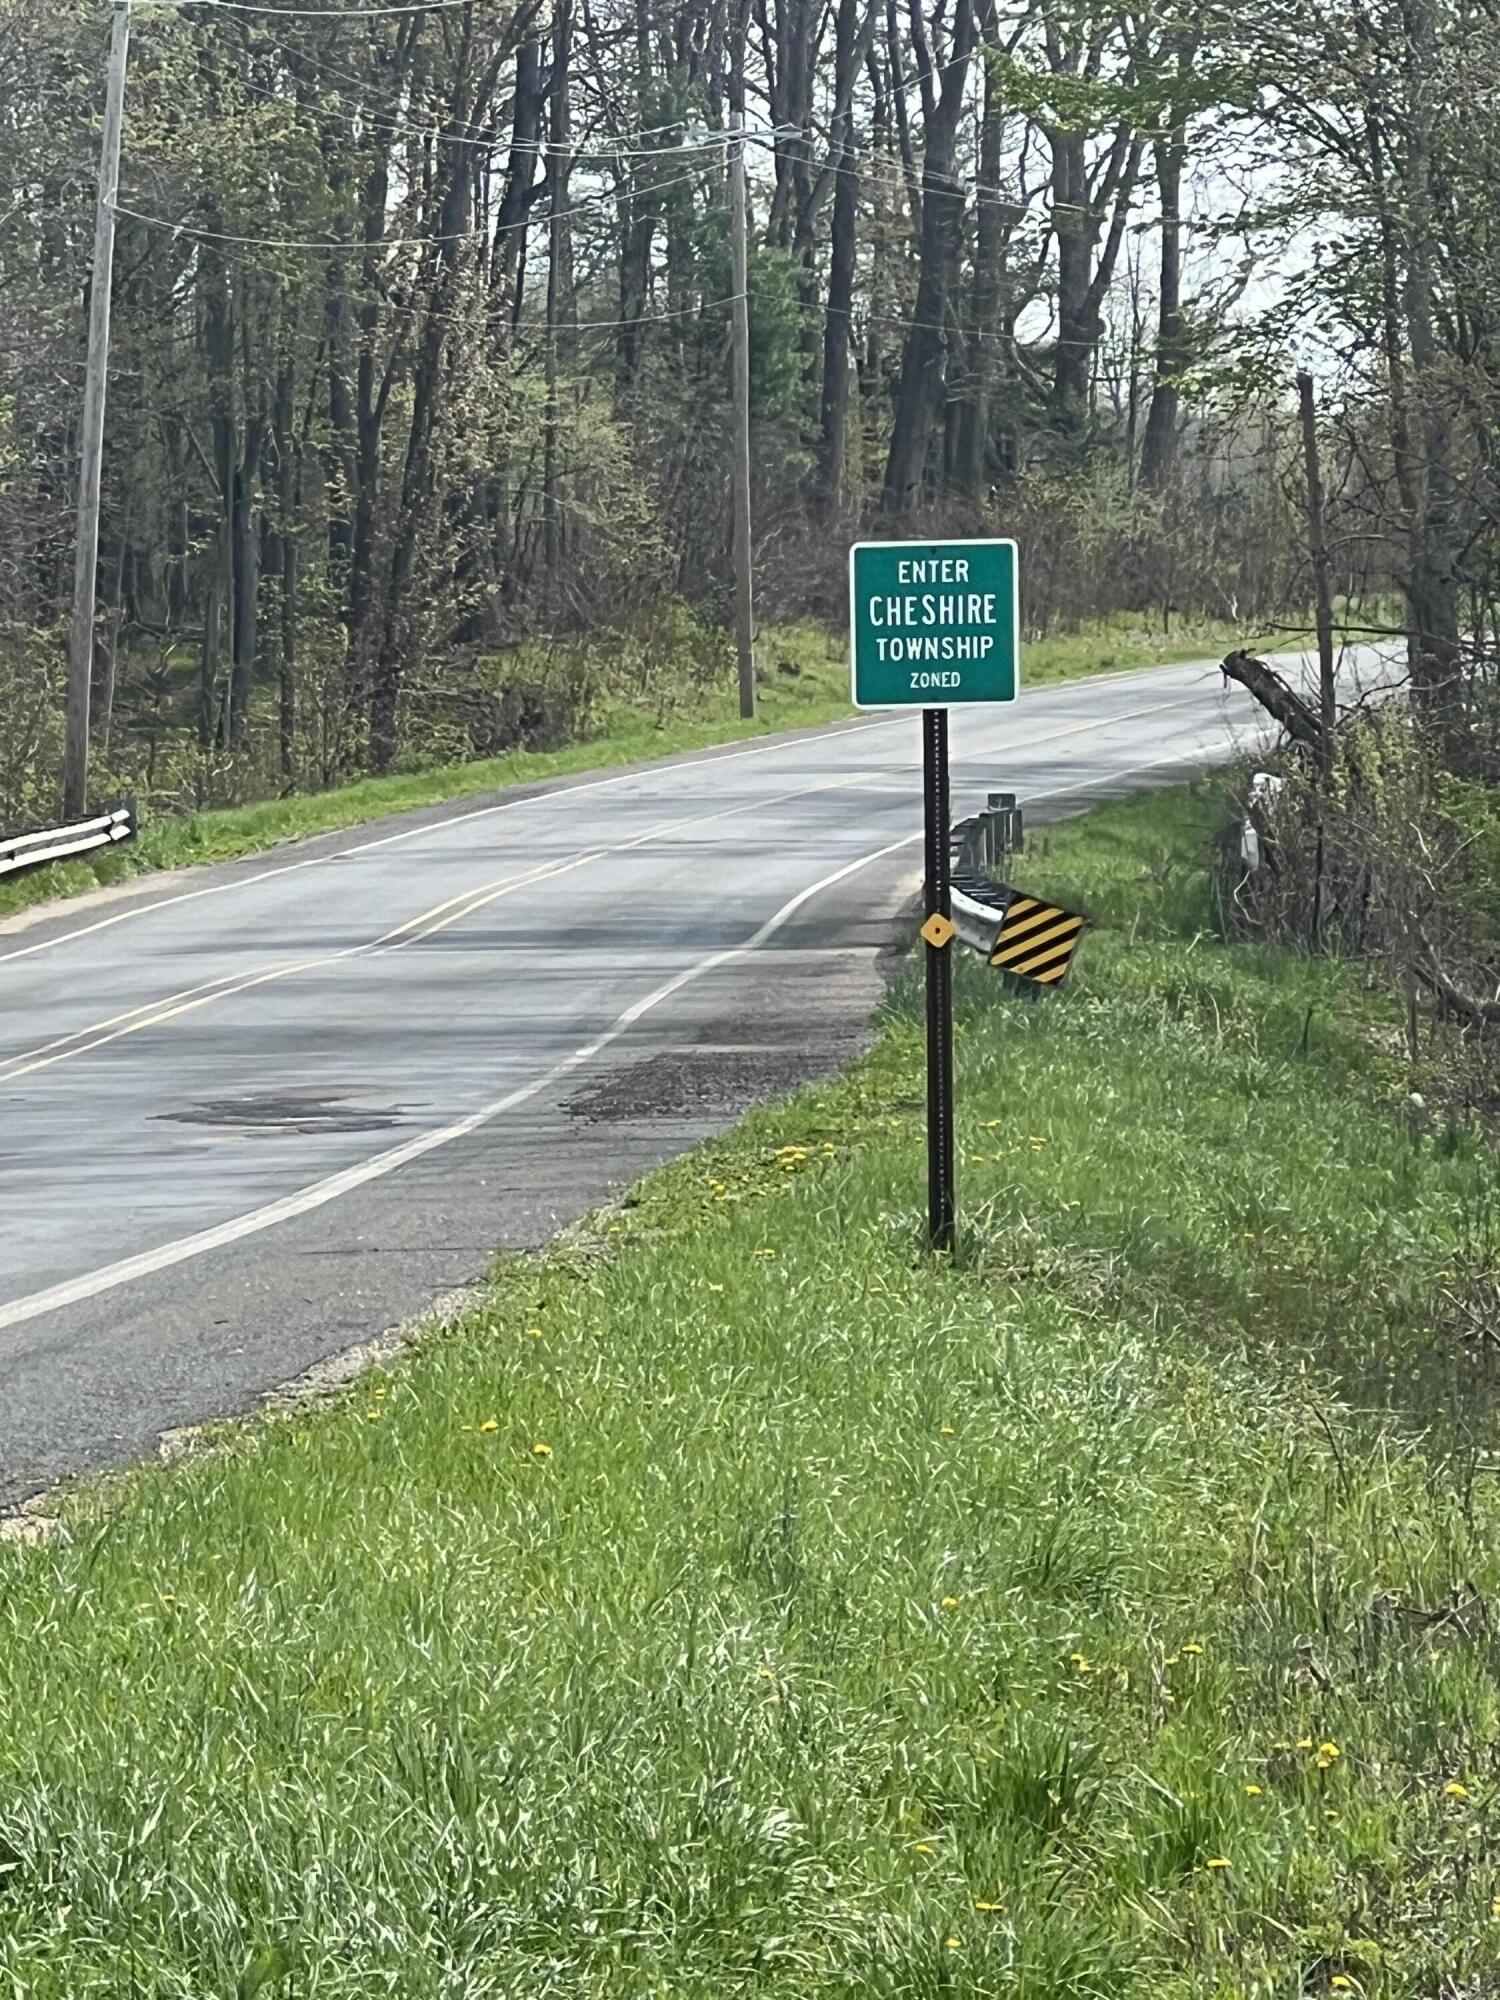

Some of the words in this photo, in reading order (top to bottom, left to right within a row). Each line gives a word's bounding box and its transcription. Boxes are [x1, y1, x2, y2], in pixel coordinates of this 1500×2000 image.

[899, 560, 968, 583] ENTER
[870, 594, 996, 625] CHESHIRE
[877, 636, 993, 661] TOWNSHIP
[911, 672, 960, 688] ZONED
